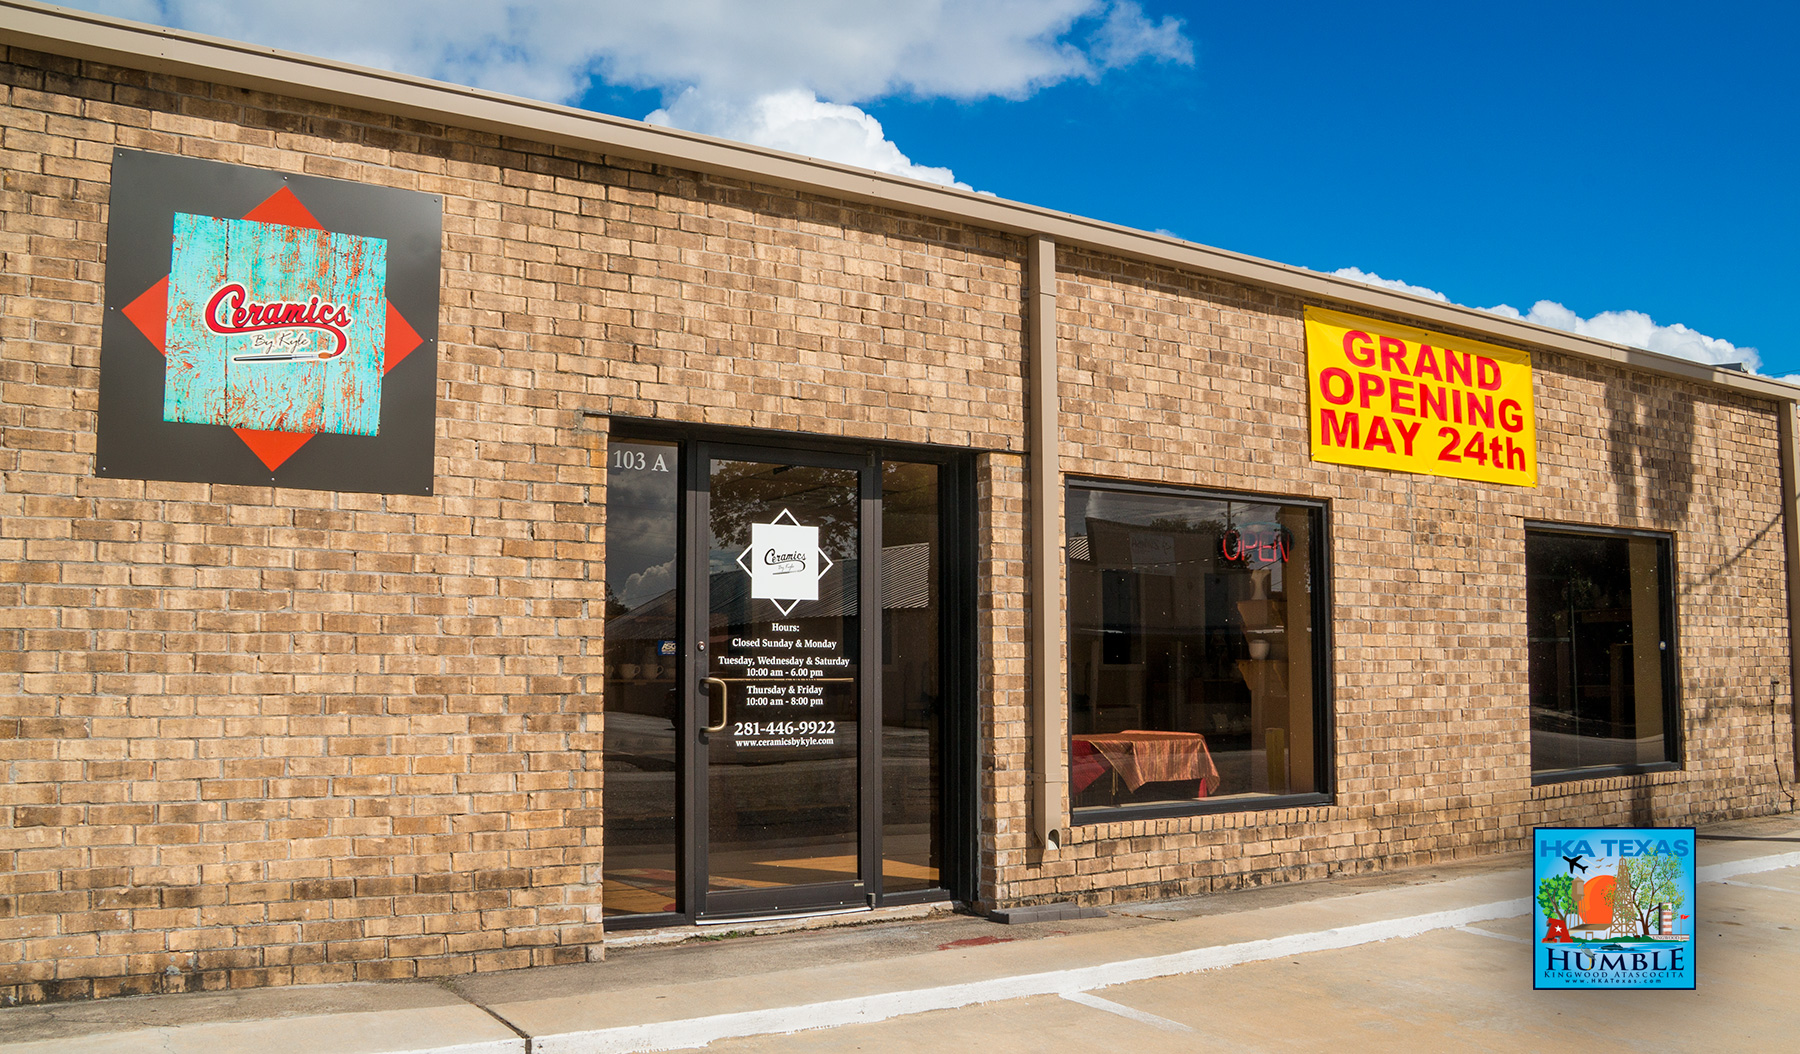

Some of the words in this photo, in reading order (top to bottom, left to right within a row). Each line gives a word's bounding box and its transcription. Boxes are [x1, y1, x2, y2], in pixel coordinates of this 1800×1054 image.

[205, 284, 351, 334] Ceramics
[253, 334, 274, 354] By
[279, 333, 309, 353] Kyle
[1342, 330, 1502, 391] GRAND
[1319, 367, 1524, 433] OPENING
[1320, 408, 1422, 457] MAY
[1437, 427, 1526, 472] 24th
[613, 450, 646, 471] 103
[651, 453, 669, 473] A
[1222, 529, 1290, 563] OPEN
[764, 548, 806, 566] Ceramics
[771, 622, 800, 632] Hours:
[732, 638, 760, 647] Closed
[762, 639, 794, 649] Sunday
[795, 640, 803, 648] &
[804, 639, 837, 650] Monday
[718, 655, 756, 666] Tuesday,
[757, 656, 804, 667] Wednesday
[806, 657, 813, 665] &
[814, 656, 850, 667] Saturday
[746, 668, 768, 677] 10:00
[810, 669, 823, 678] pm
[746, 685, 786, 696] Thursday
[788, 686, 796, 694] &
[797, 685, 823, 696] Friday
[746, 697, 768, 706] 10:00
[770, 698, 784, 706] am
[790, 697, 808, 706] 8:00
[810, 698, 824, 707] pm
[733, 721, 836, 736] 281-446-9922
[735, 737, 834, 747] www.ceramicsbykyle.com
